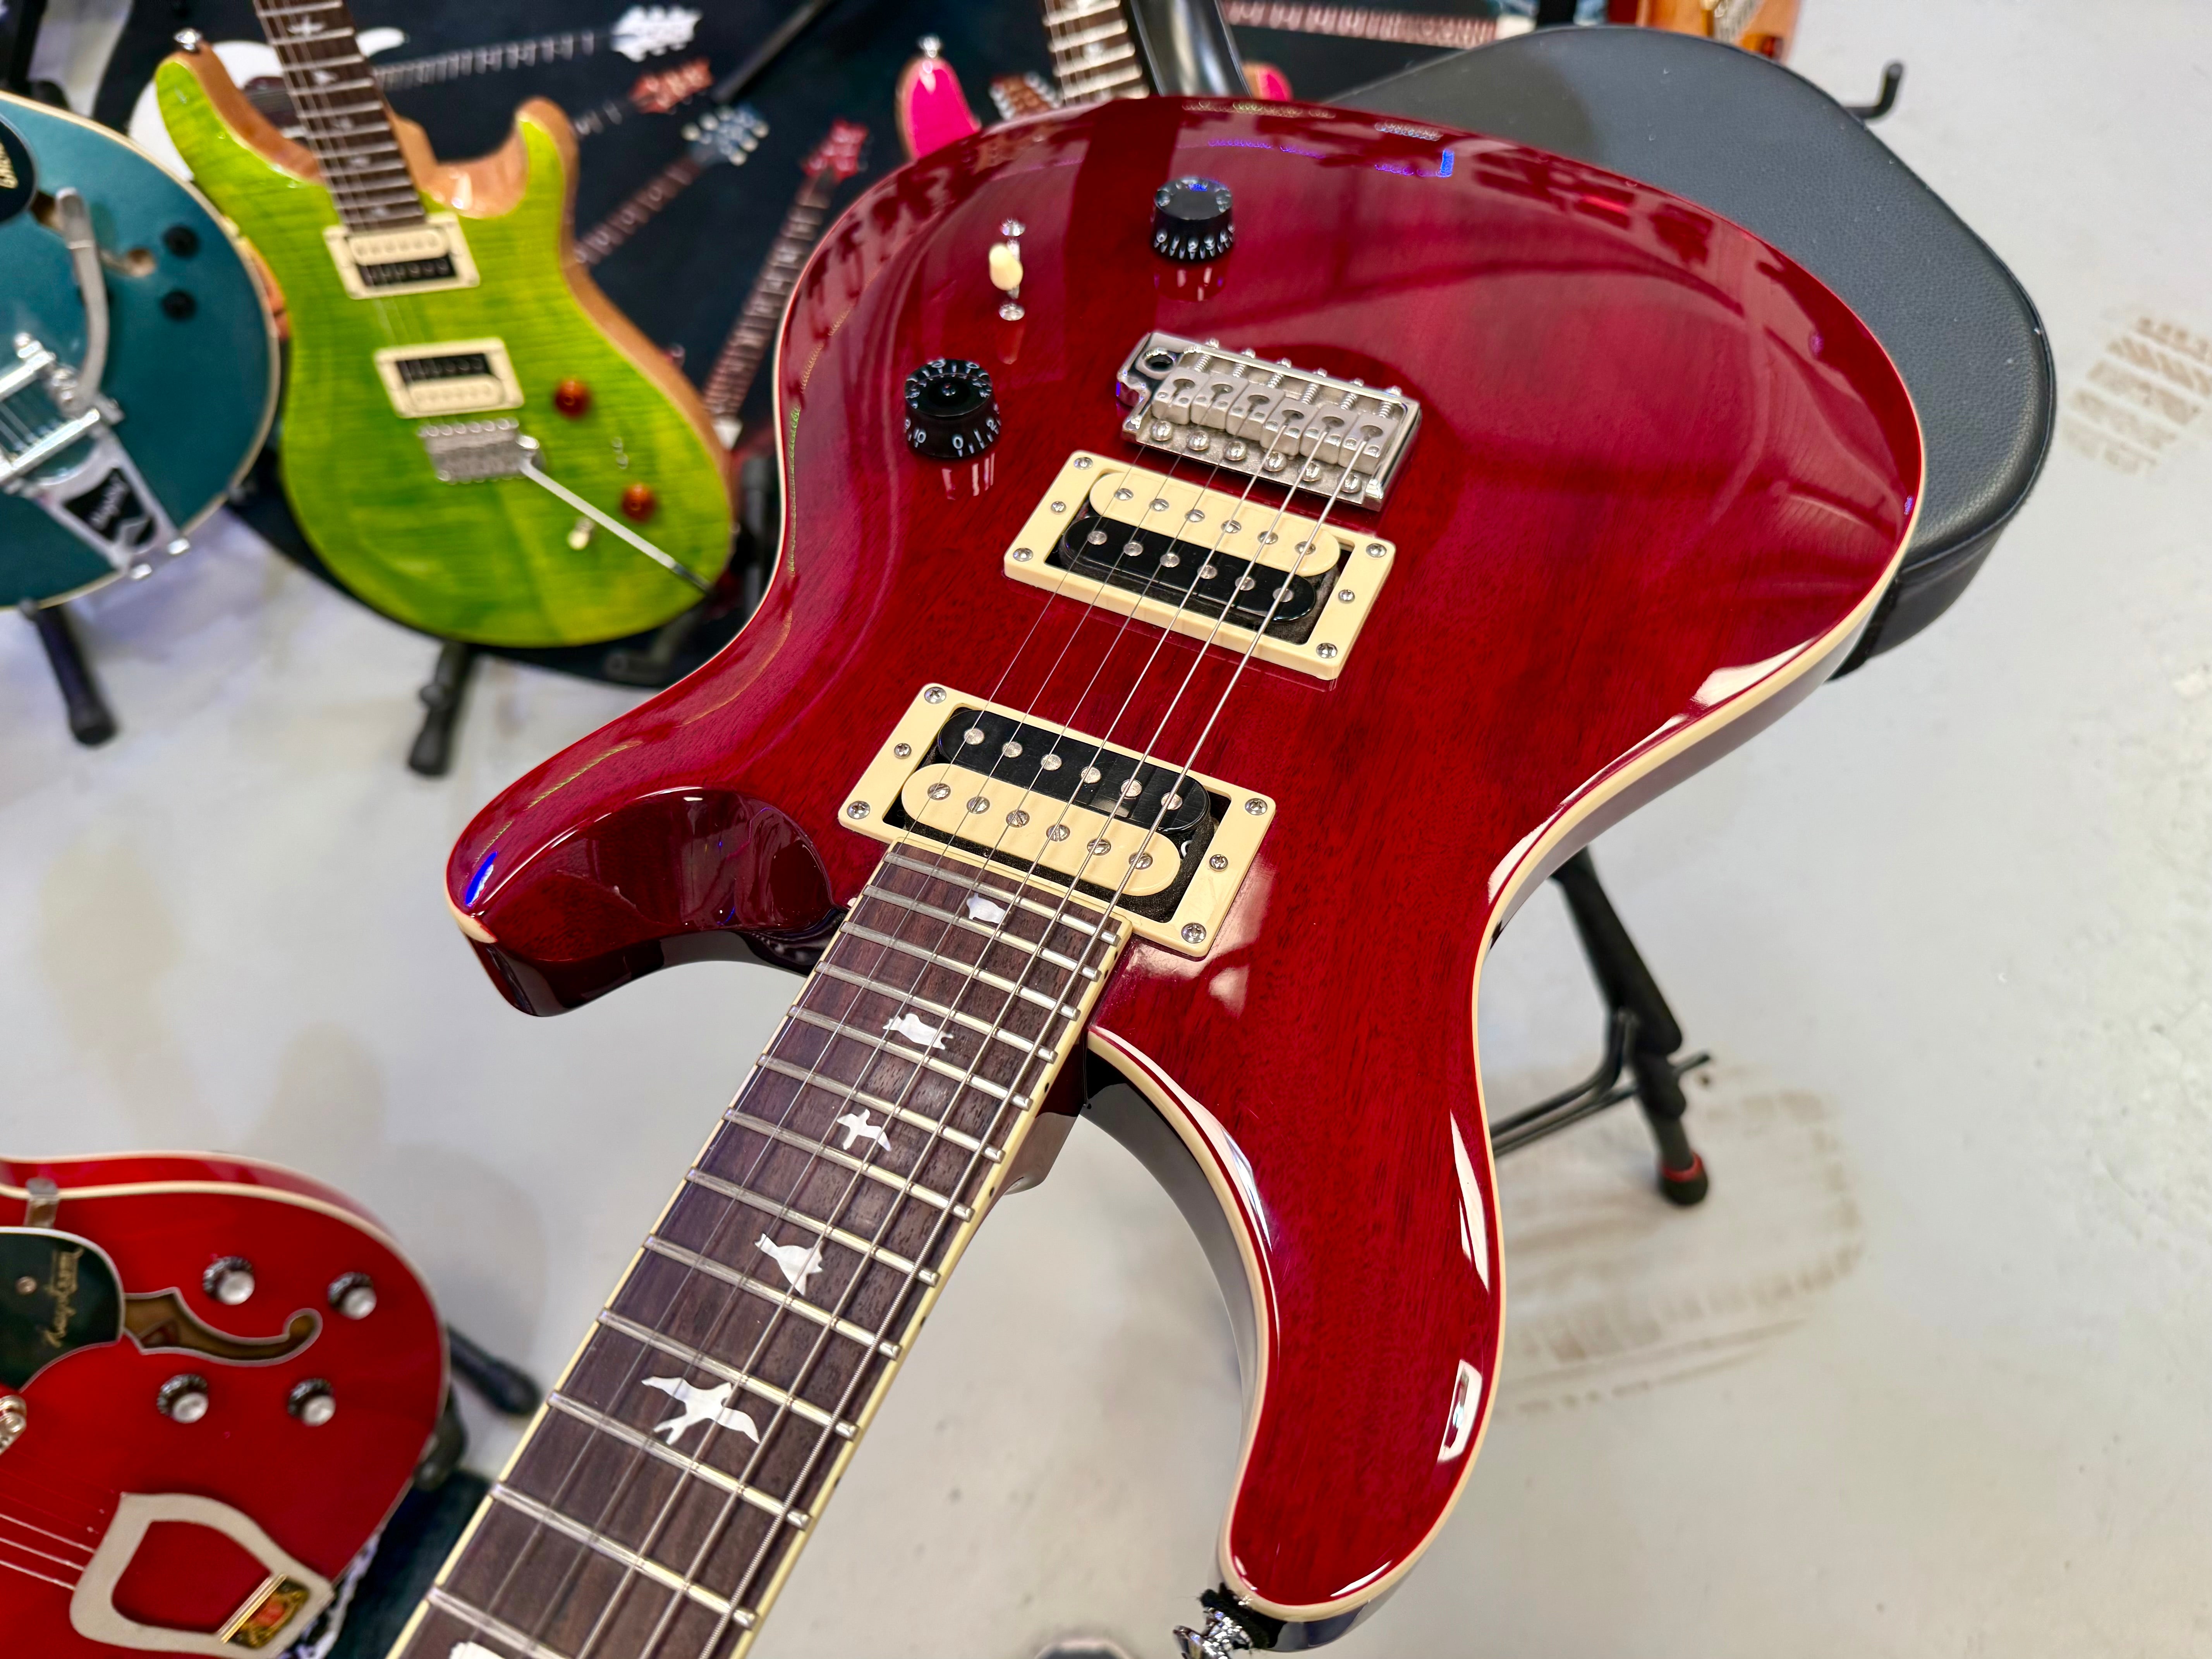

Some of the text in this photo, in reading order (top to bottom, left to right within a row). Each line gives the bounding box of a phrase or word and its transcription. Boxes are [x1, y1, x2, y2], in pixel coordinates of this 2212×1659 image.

[914, 428, 927, 443] 10
[952, 434, 963, 449] 0
[986, 417, 997, 431] 2
